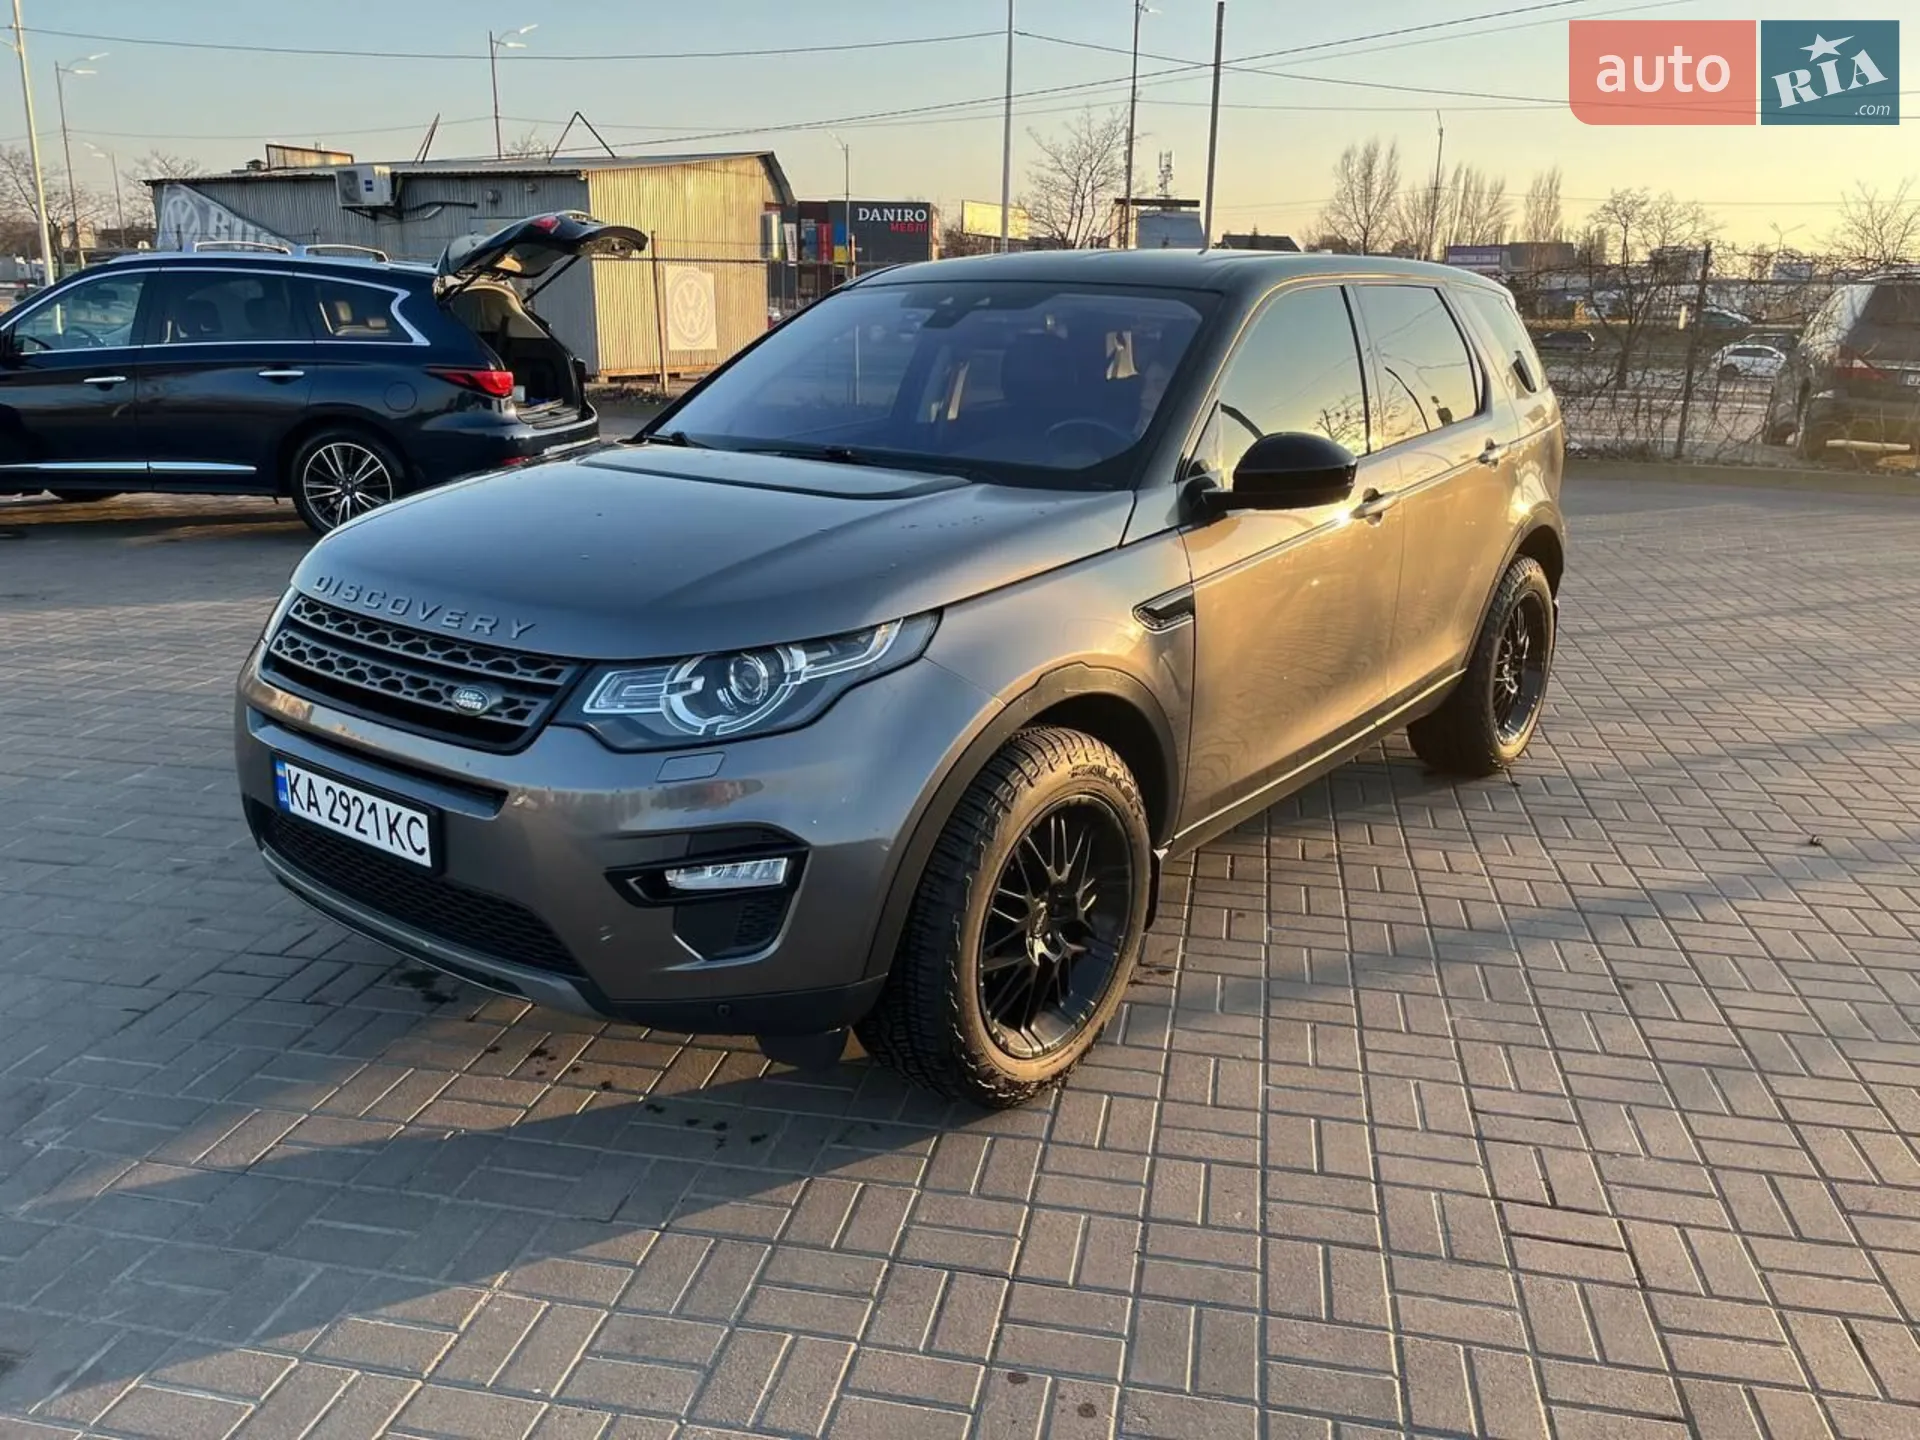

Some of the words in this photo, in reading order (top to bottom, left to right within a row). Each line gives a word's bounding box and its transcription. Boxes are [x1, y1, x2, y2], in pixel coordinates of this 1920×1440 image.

[858, 207, 927, 222] DANIRO
[313, 575, 536, 640] DISCOVERY
[287, 769, 322, 818] KA
[325, 785, 381, 841] 2921
[385, 807, 427, 857] KC
